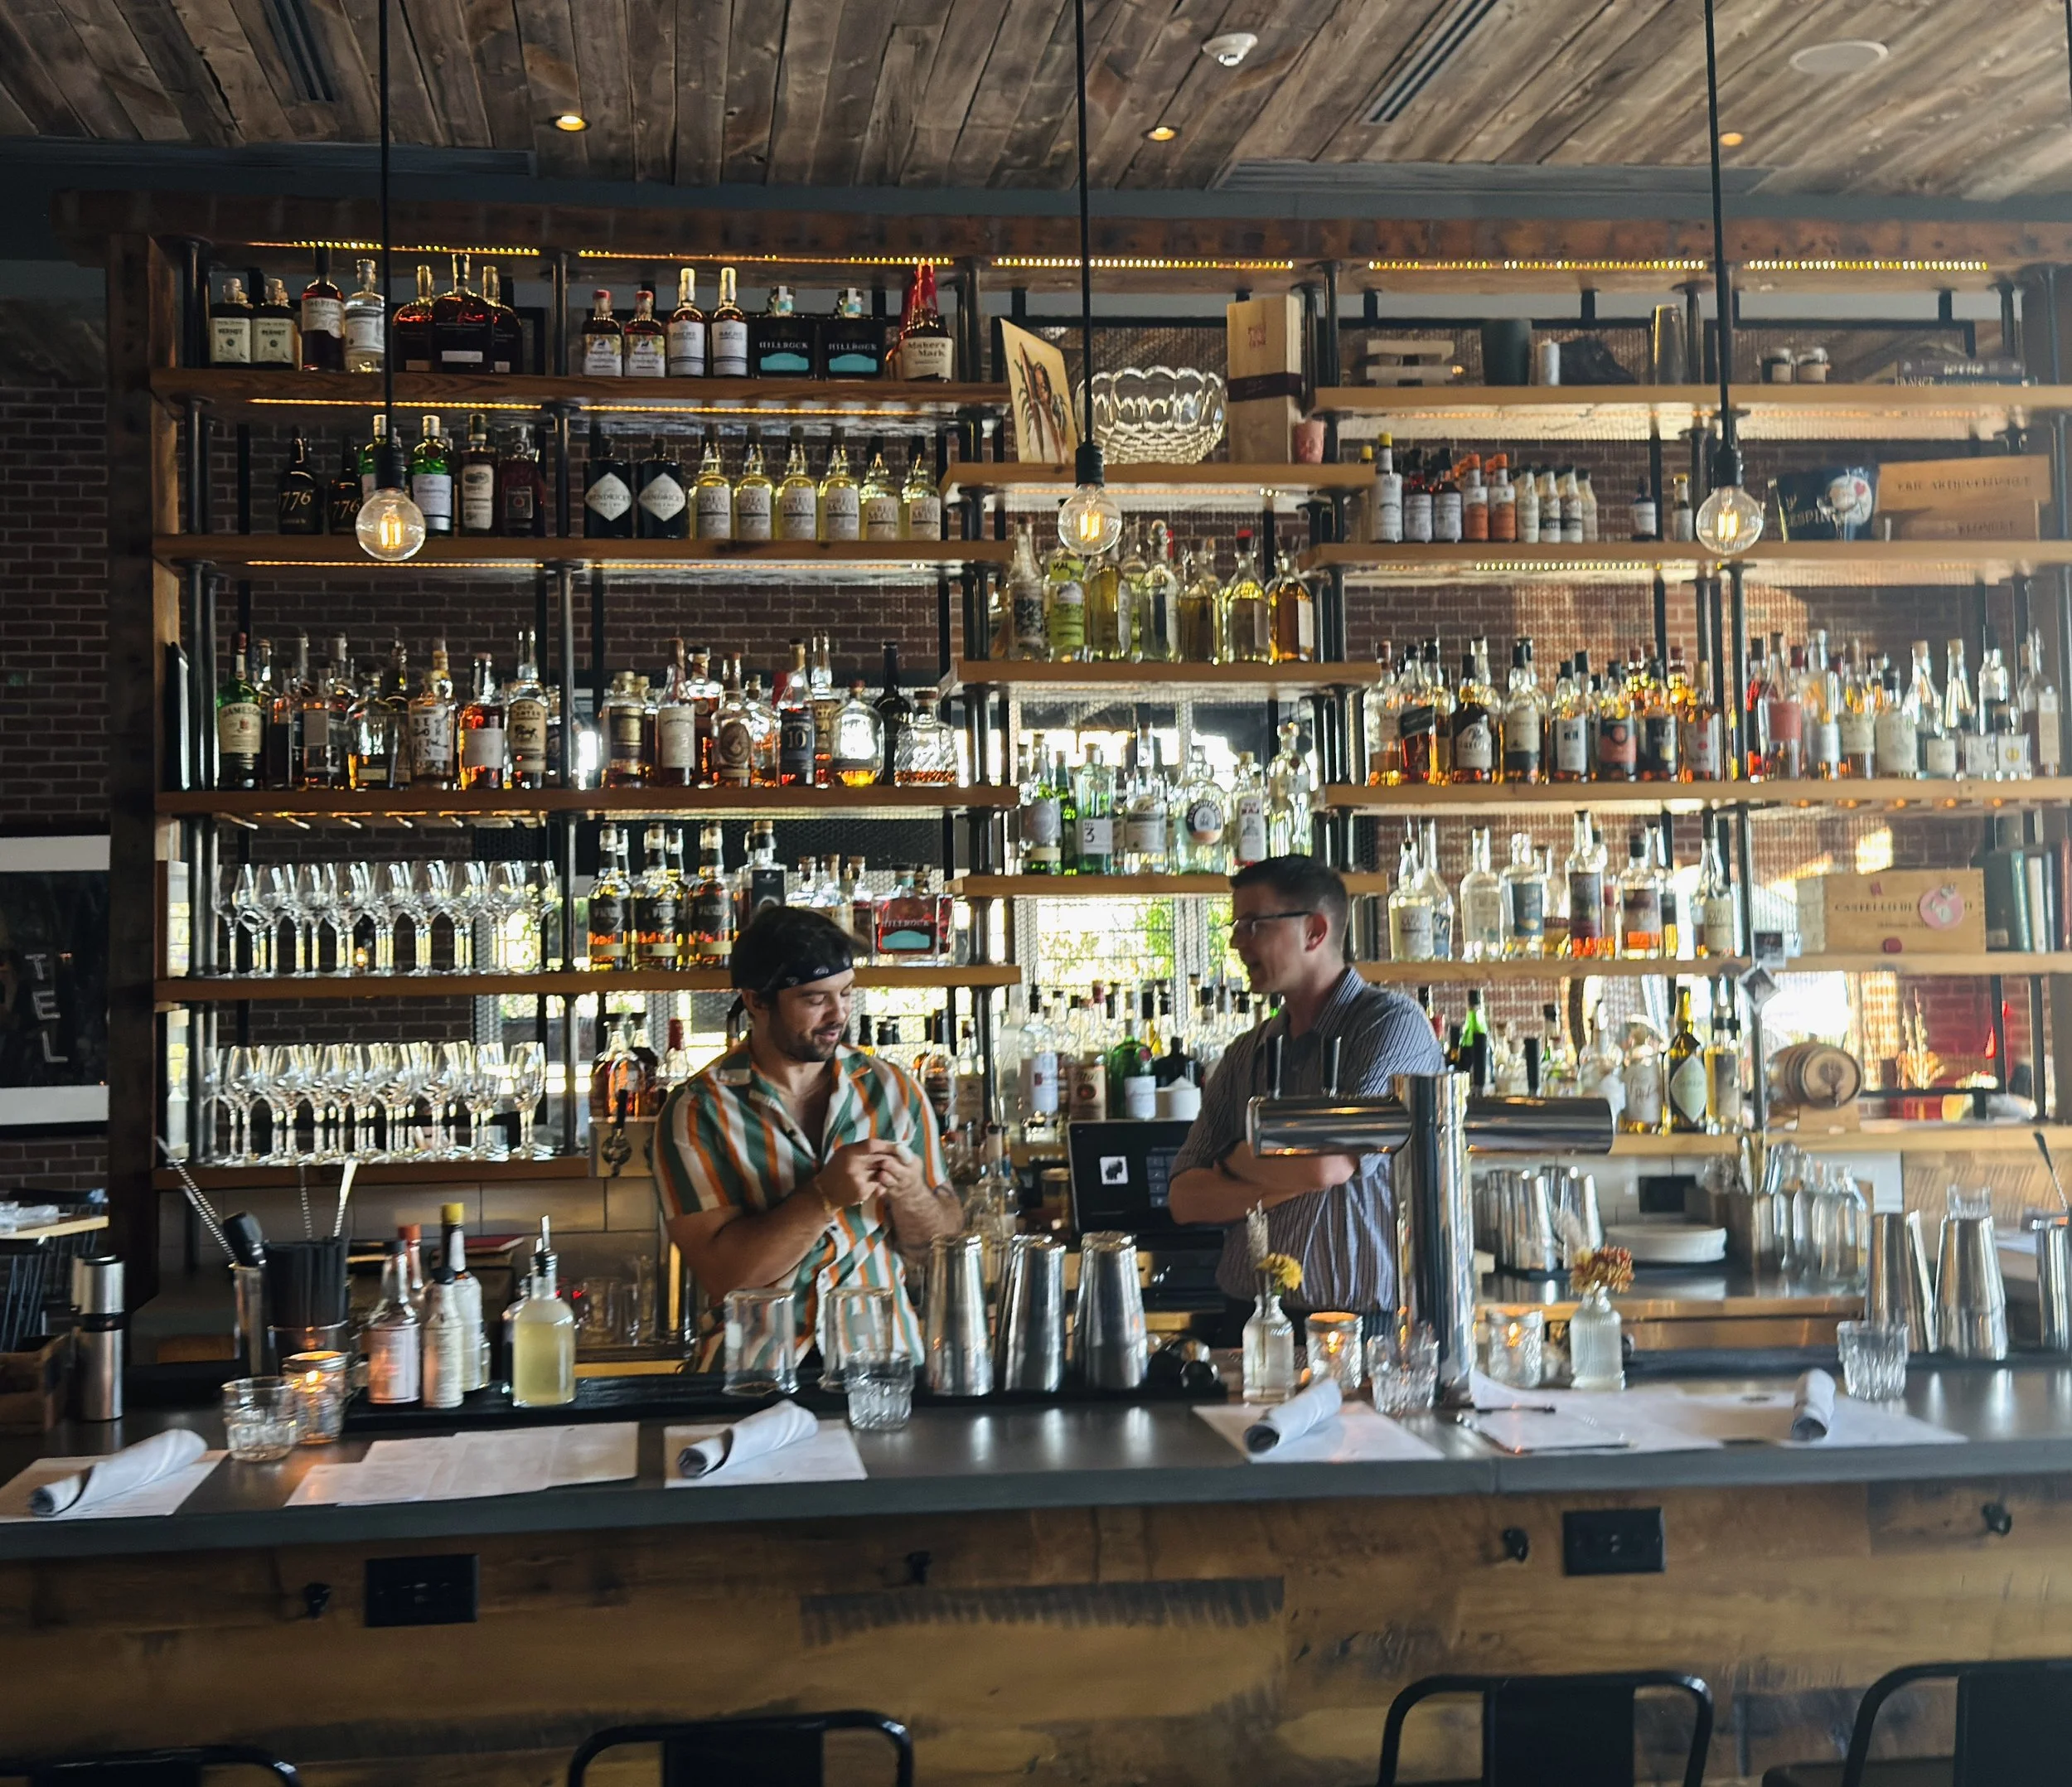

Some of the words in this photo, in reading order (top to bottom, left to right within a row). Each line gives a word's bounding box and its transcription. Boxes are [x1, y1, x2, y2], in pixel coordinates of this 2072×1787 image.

[758, 341, 809, 350] HILLROCK
[828, 342, 878, 351] HILLROCK
[332, 498, 361, 521] 776
[222, 706, 262, 719] JAMESON
[787, 730, 807, 748] 10
[1084, 827, 1095, 844] 3
